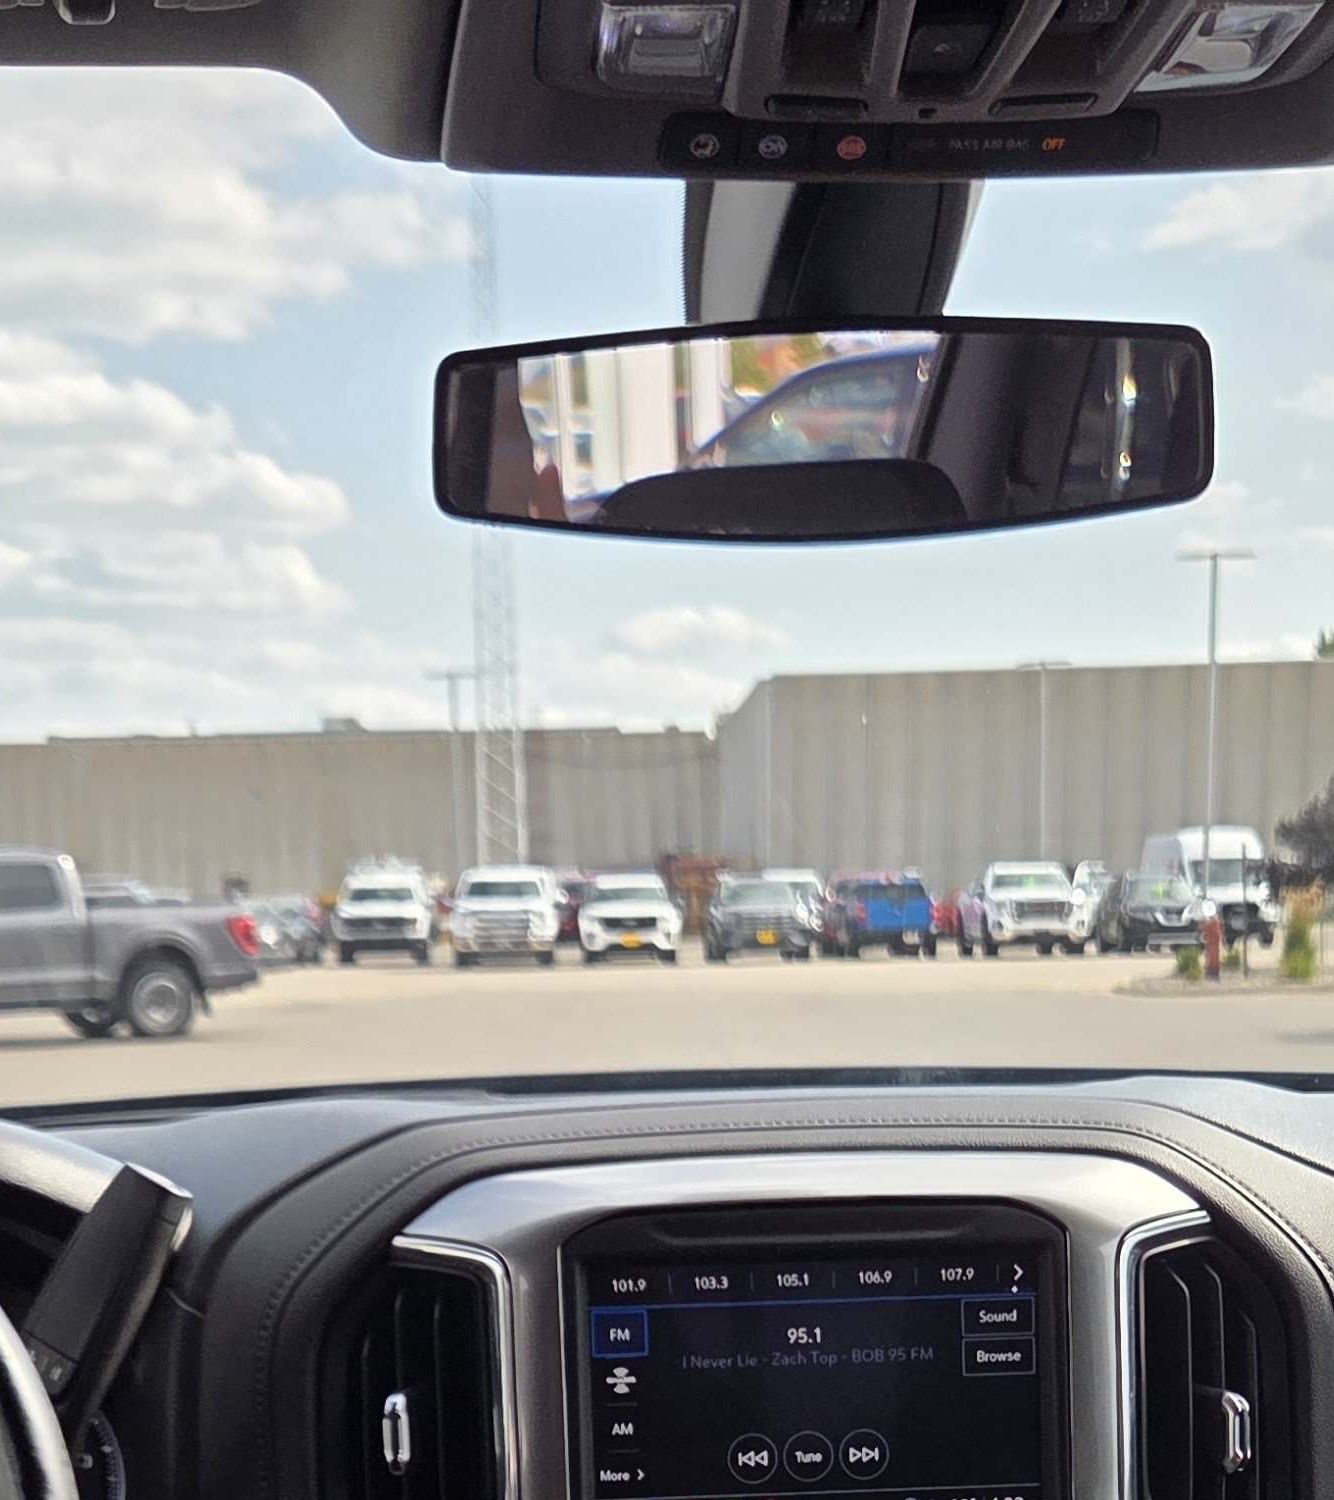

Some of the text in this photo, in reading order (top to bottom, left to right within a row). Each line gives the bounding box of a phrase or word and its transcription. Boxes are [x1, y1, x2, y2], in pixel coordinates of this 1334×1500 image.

[1041, 136, 1066, 151] OFF
[612, 1267, 975, 1293] 101.9 103.3 105.1 106.9 107.9
[979, 1309, 1017, 1323] Sound
[609, 1328, 630, 1342] FM
[787, 1327, 821, 1343] 95.1
[691, 1354, 732, 1368] Never
[738, 1353, 758, 1367] Lie
[771, 1351, 807, 1366] Zach
[811, 1351, 838, 1368] Top
[852, 1348, 885, 1363] BOB
[889, 1348, 906, 1362] 95
[911, 1347, 934, 1361] FM
[976, 1349, 1021, 1363] Browse
[611, 1422, 634, 1436] AM
[795, 1451, 823, 1463] Tune
[599, 1469, 630, 1482] More
